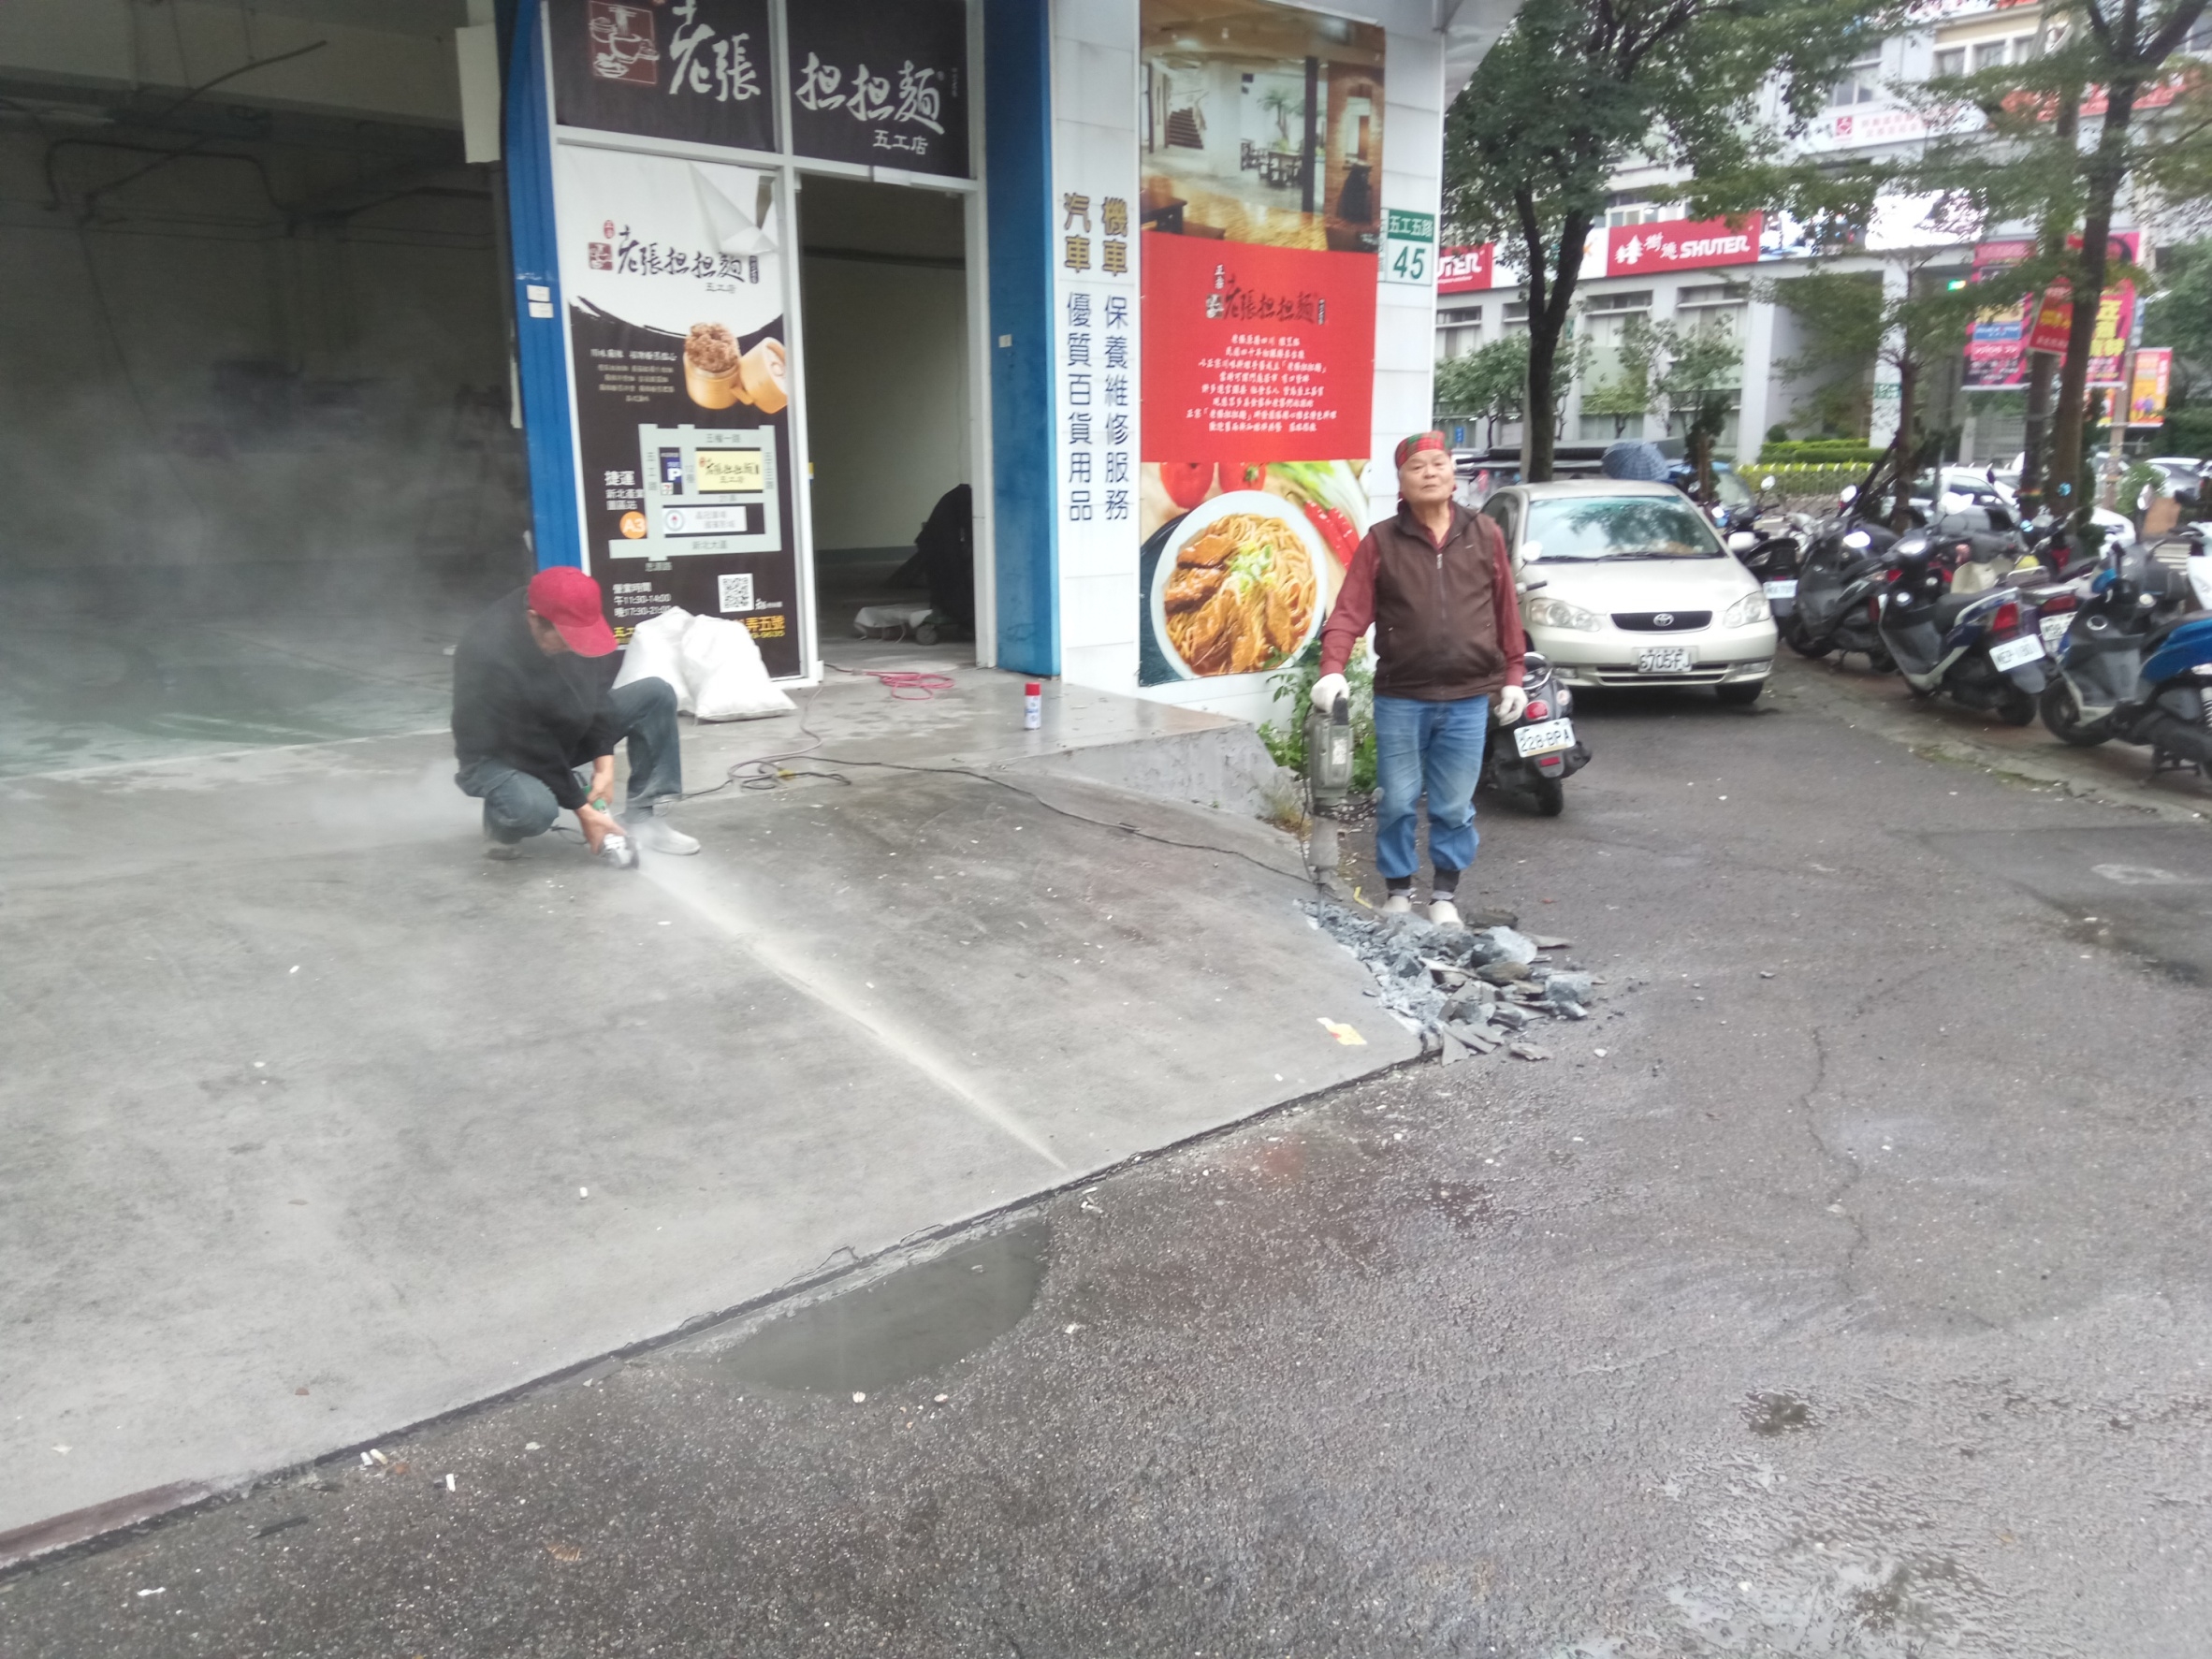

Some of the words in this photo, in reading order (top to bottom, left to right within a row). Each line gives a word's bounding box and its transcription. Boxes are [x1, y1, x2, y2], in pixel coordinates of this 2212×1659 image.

[873, 129, 928, 155] 五工店
[1063, 192, 1092, 274] 汽車
[1101, 196, 1129, 278] 機車
[1389, 214, 1433, 238] 五工五路
[1680, 235, 1751, 259] SHUTER
[1393, 245, 1426, 280] 45
[1067, 291, 1093, 521] 優質百貨用品
[1104, 295, 1129, 521] 保養維修服務
[604, 470, 635, 486] 捷運
[667, 468, 682, 481] P
[622, 517, 647, 532] A3
